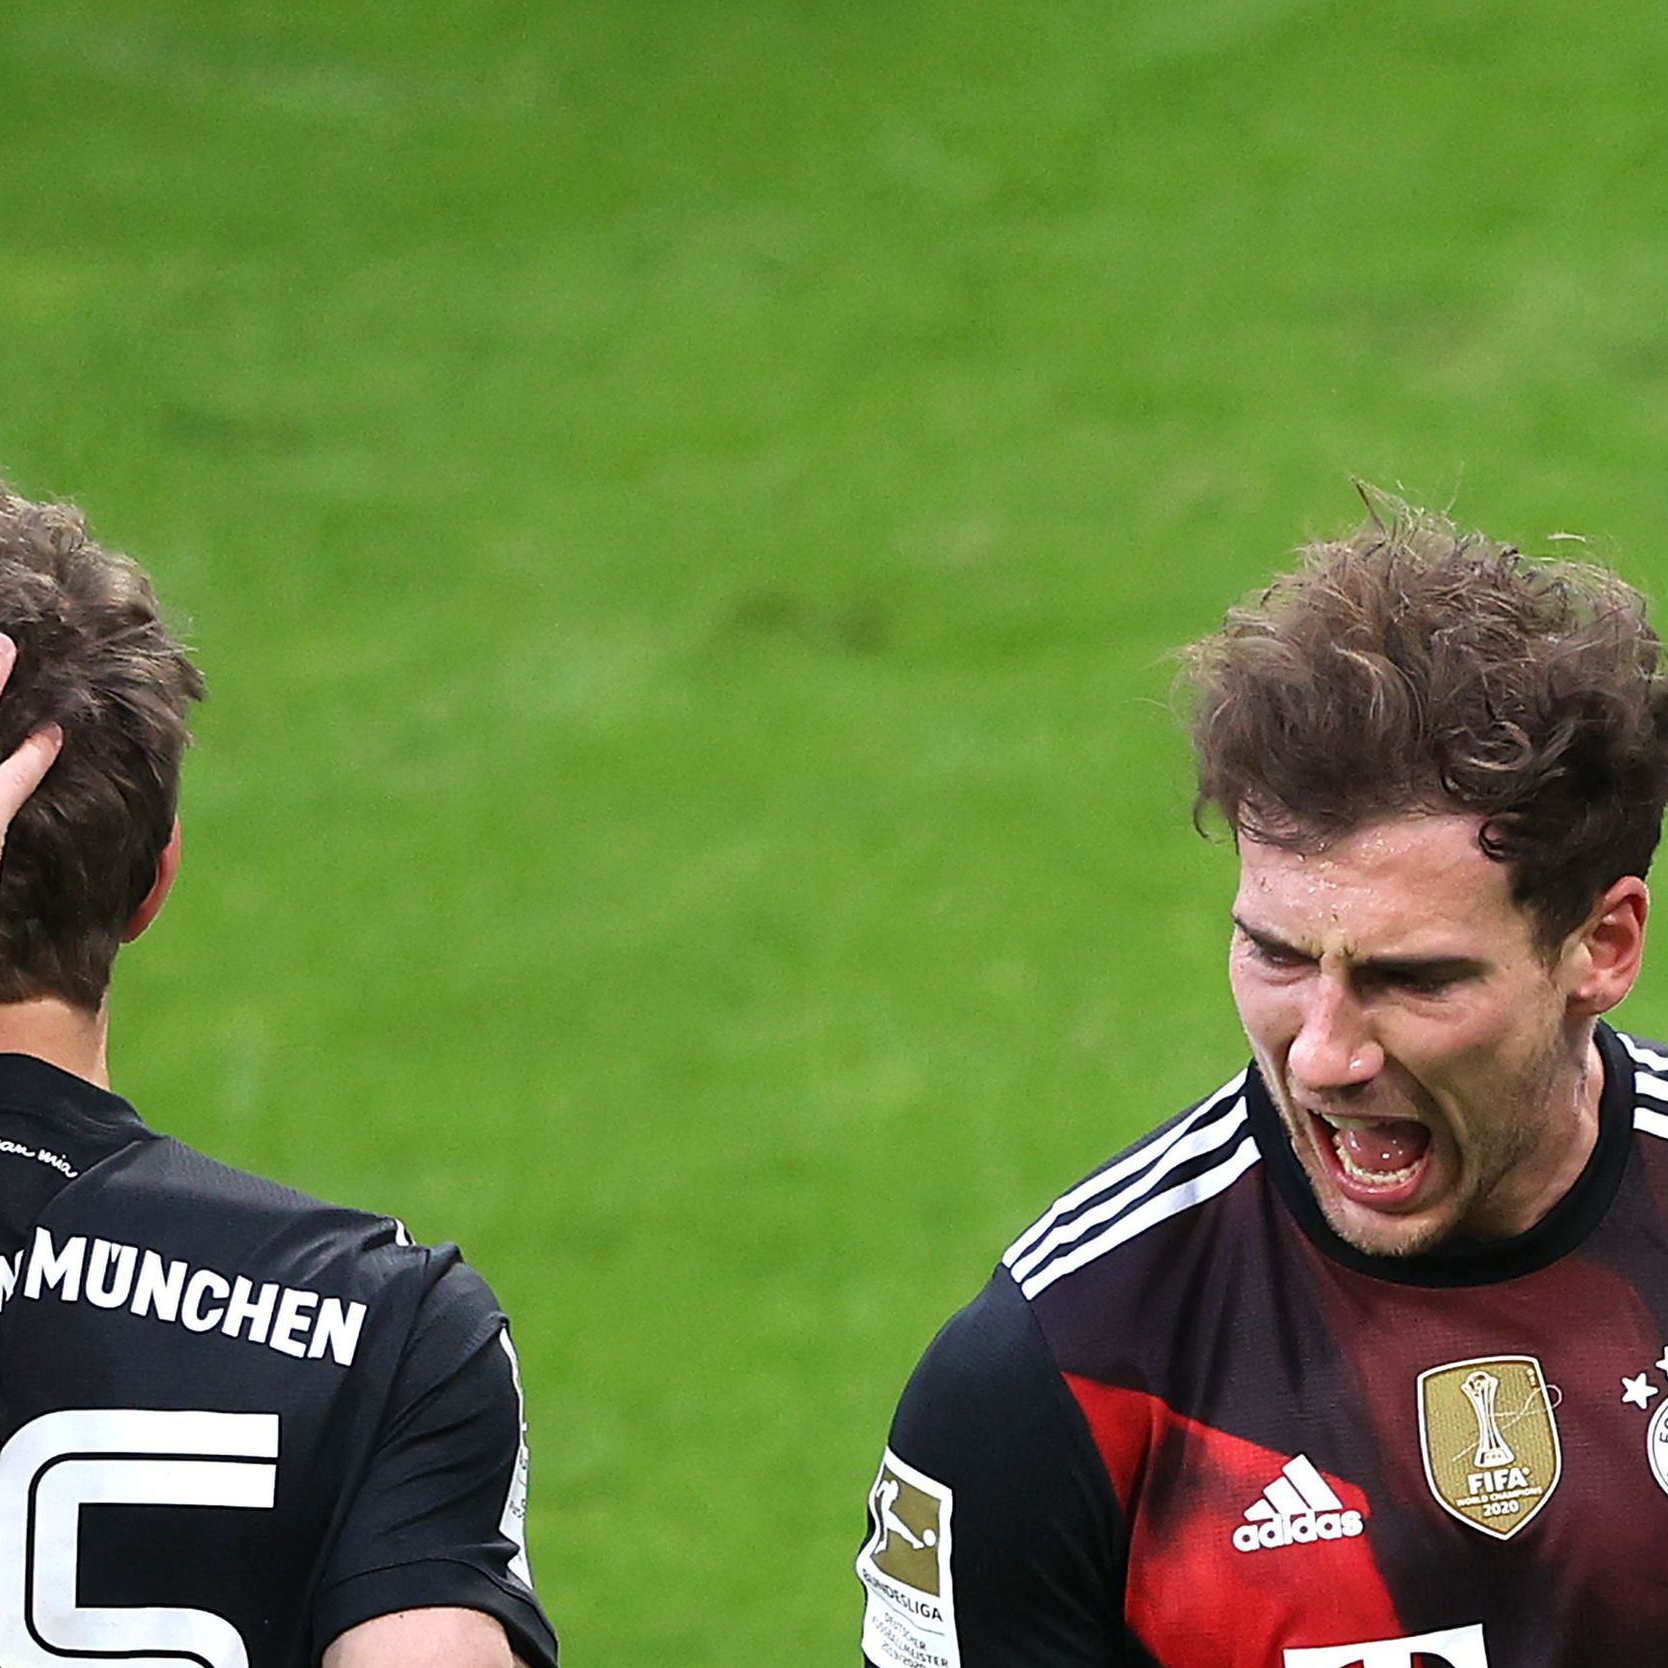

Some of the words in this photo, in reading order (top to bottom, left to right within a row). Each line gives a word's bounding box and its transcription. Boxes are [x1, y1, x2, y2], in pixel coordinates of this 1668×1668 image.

[37, 1149, 78, 1178] mia
[23, 1226, 368, 1367] MÜNCHEN
[1467, 1467, 1530, 1496] FIFA
[1456, 1493, 1489, 1507] WORLD
[1489, 1486, 1543, 1502] CHAMPIONS
[1482, 1499, 1520, 1518] 2020
[1233, 1510, 1364, 1552] adidas
